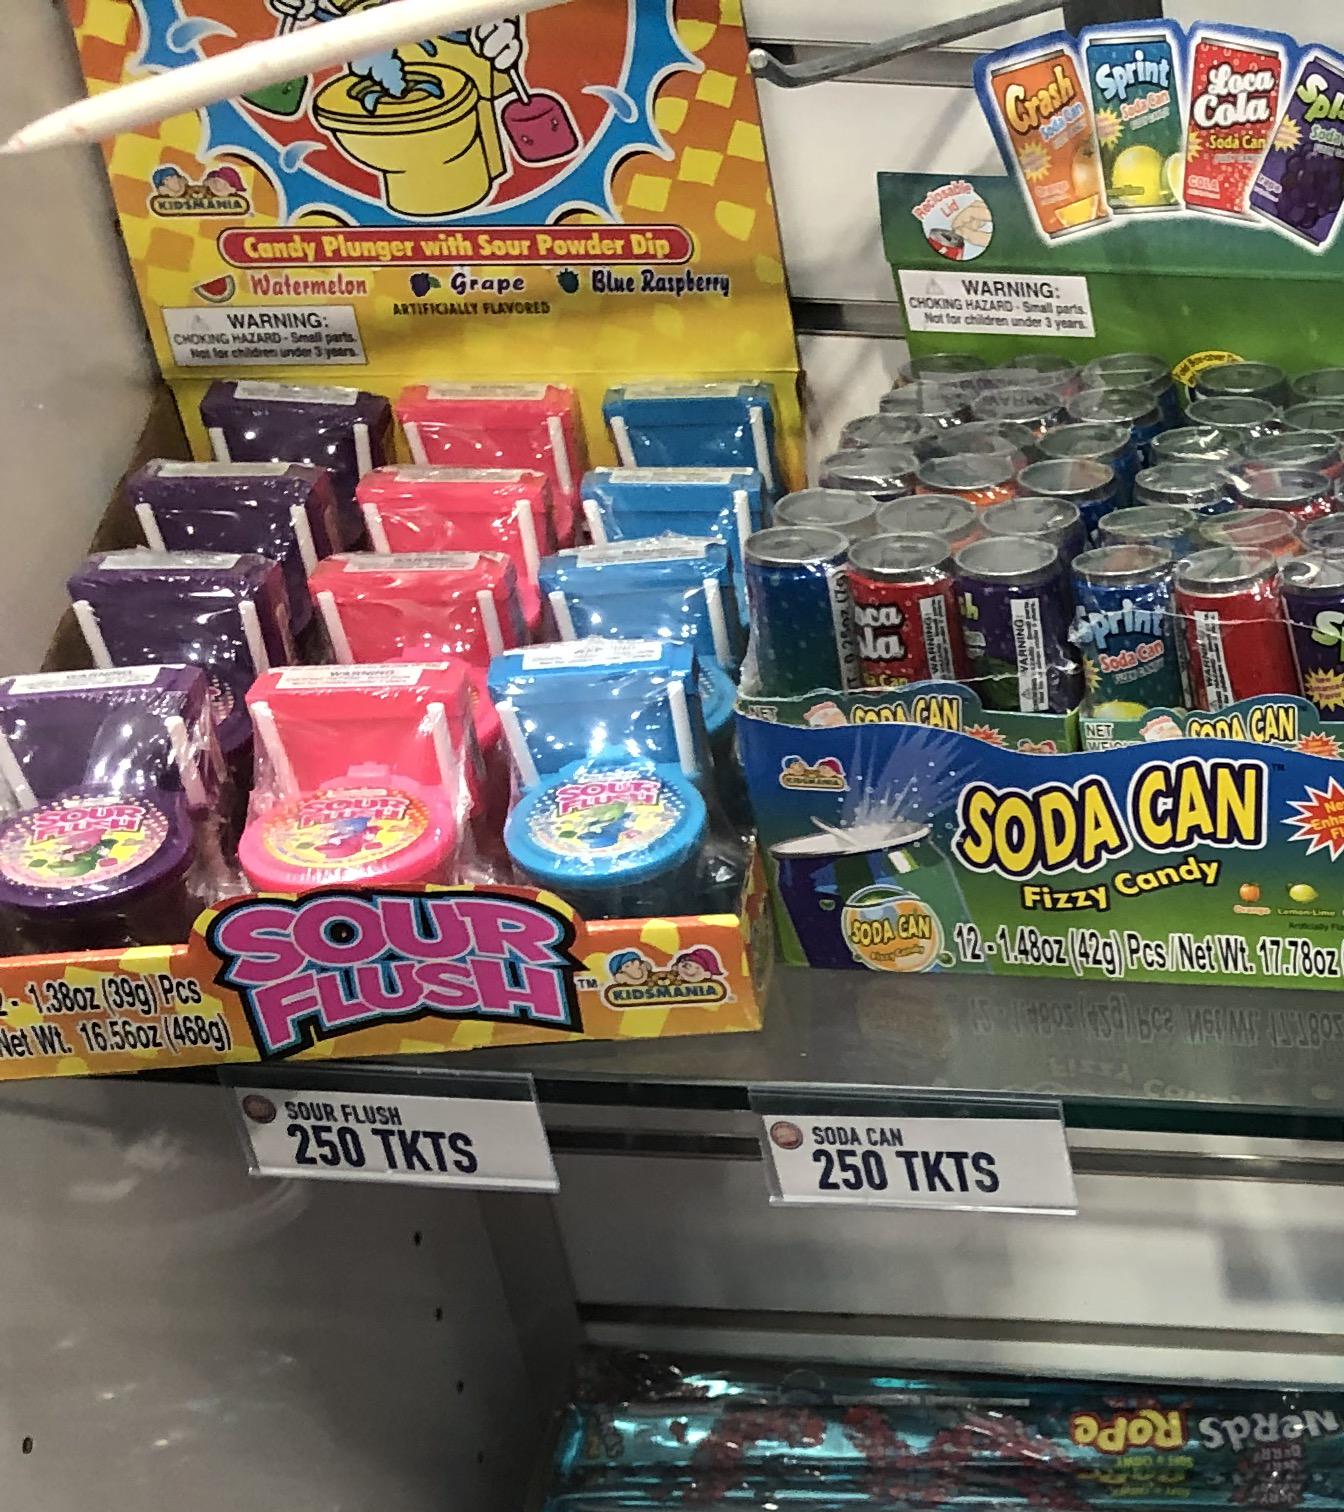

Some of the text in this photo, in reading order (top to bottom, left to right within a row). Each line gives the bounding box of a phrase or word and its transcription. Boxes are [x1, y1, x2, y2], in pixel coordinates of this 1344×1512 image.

[1095, 50, 1172, 100] Sprint
[1208, 63, 1274, 95] Loca
[1004, 65, 1075, 134] Crash
[1194, 91, 1269, 128] Cola
[243, 233, 670, 262] Candy Plunger with Sour Powder Dip
[249, 274, 368, 296] Watermelon
[451, 272, 524, 295] Grape
[592, 269, 730, 297] Blue Raspberry
[961, 280, 1061, 299] WARNING:
[909, 297, 1087, 315] CHOKING HAZARD Small parts.
[924, 312, 1087, 331] Not for children under 3 years.
[957, 761, 1265, 875] SODA CAN
[1023, 858, 1220, 911] Fizzy Candy
[215, 893, 562, 987] SOUR
[954, 924, 984, 962] 12
[999, 926, 1068, 965] 1.48oz
[1070, 928, 1125, 977] (42g)
[1218, 936, 1255, 974] Wt.
[1258, 937, 1340, 978] 17.78oz
[28, 974, 202, 1016] 1.38oz (39g) Pcs
[250, 955, 568, 1056] FLUSH
[612, 983, 719, 1002] KIDSMANIA
[0, 1013, 232, 1057] Net Wt. 16.56oz (468g)
[285, 1101, 403, 1128] SOUR FLUSH
[286, 1124, 478, 1175] 250 TKTS
[812, 1125, 904, 1149] SODA CAN
[814, 1149, 1001, 1194] 250 TKTS
